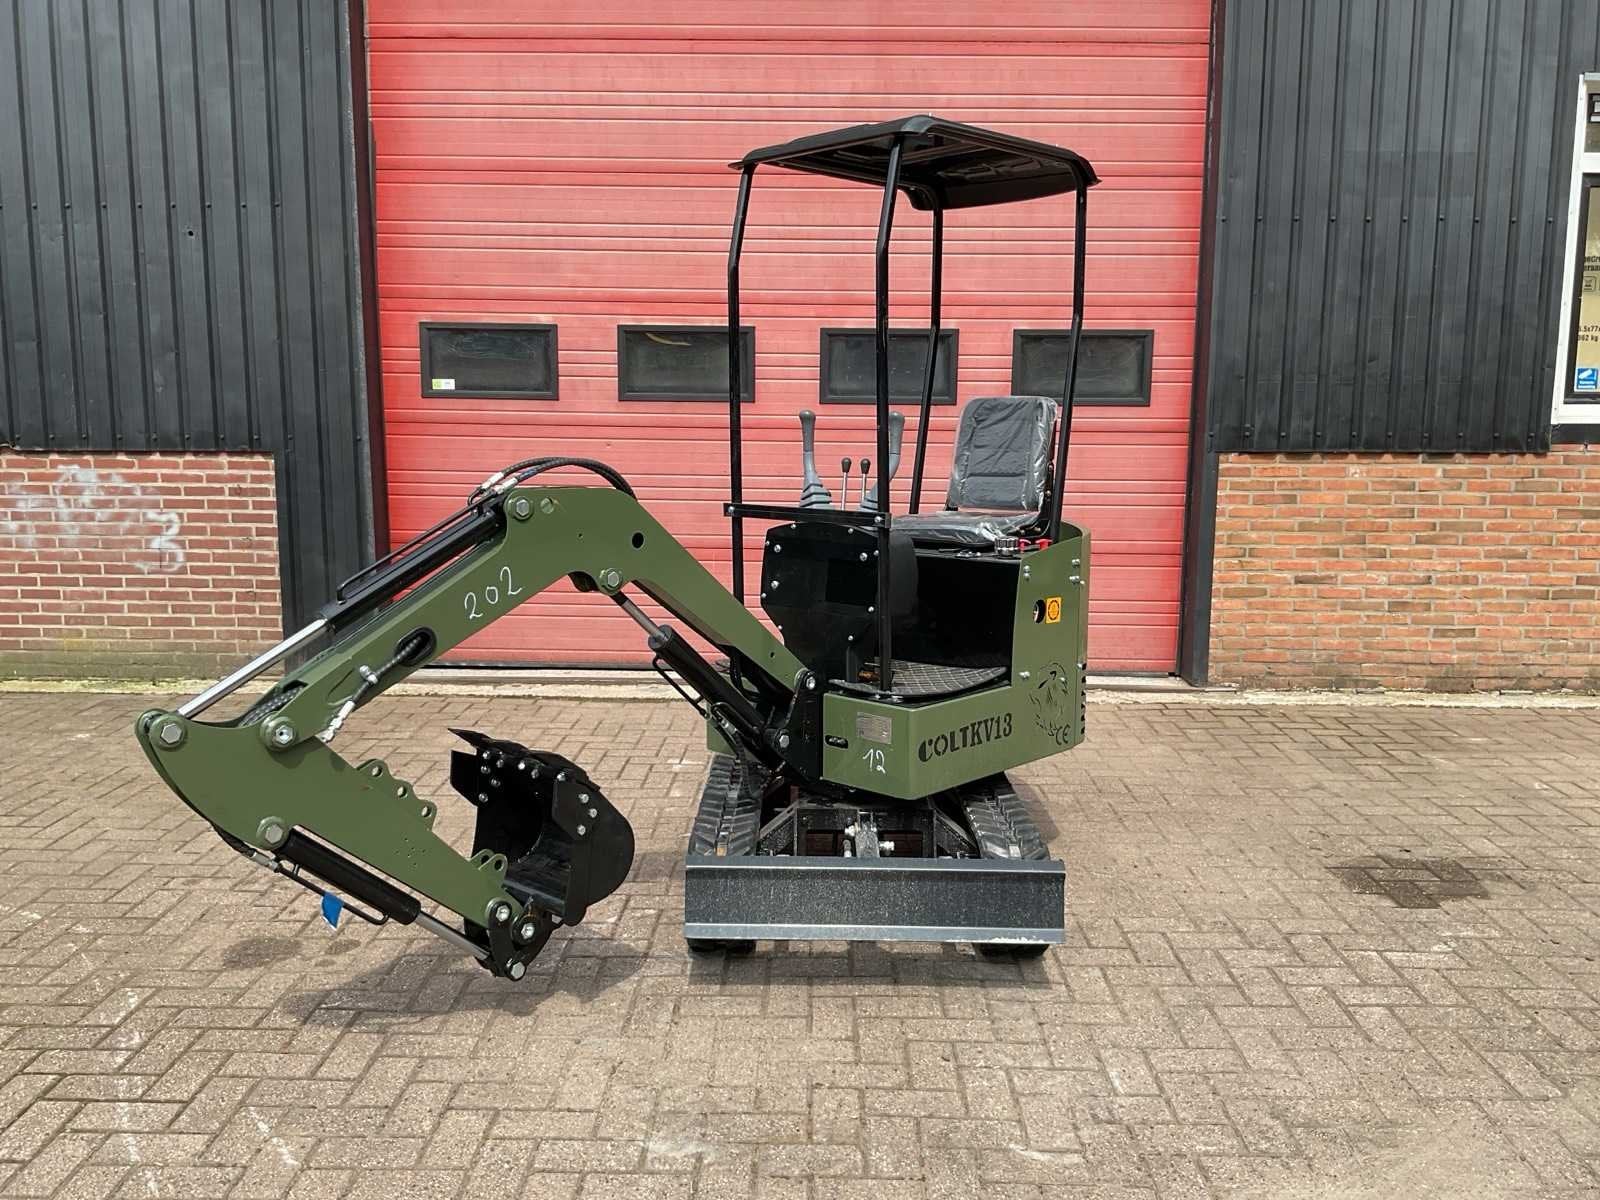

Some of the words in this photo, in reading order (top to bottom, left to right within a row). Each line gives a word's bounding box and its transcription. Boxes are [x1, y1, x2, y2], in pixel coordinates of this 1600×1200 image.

[464, 566, 523, 620] 202
[862, 748, 886, 774] 12
[918, 712, 1013, 763] COLTKV13
